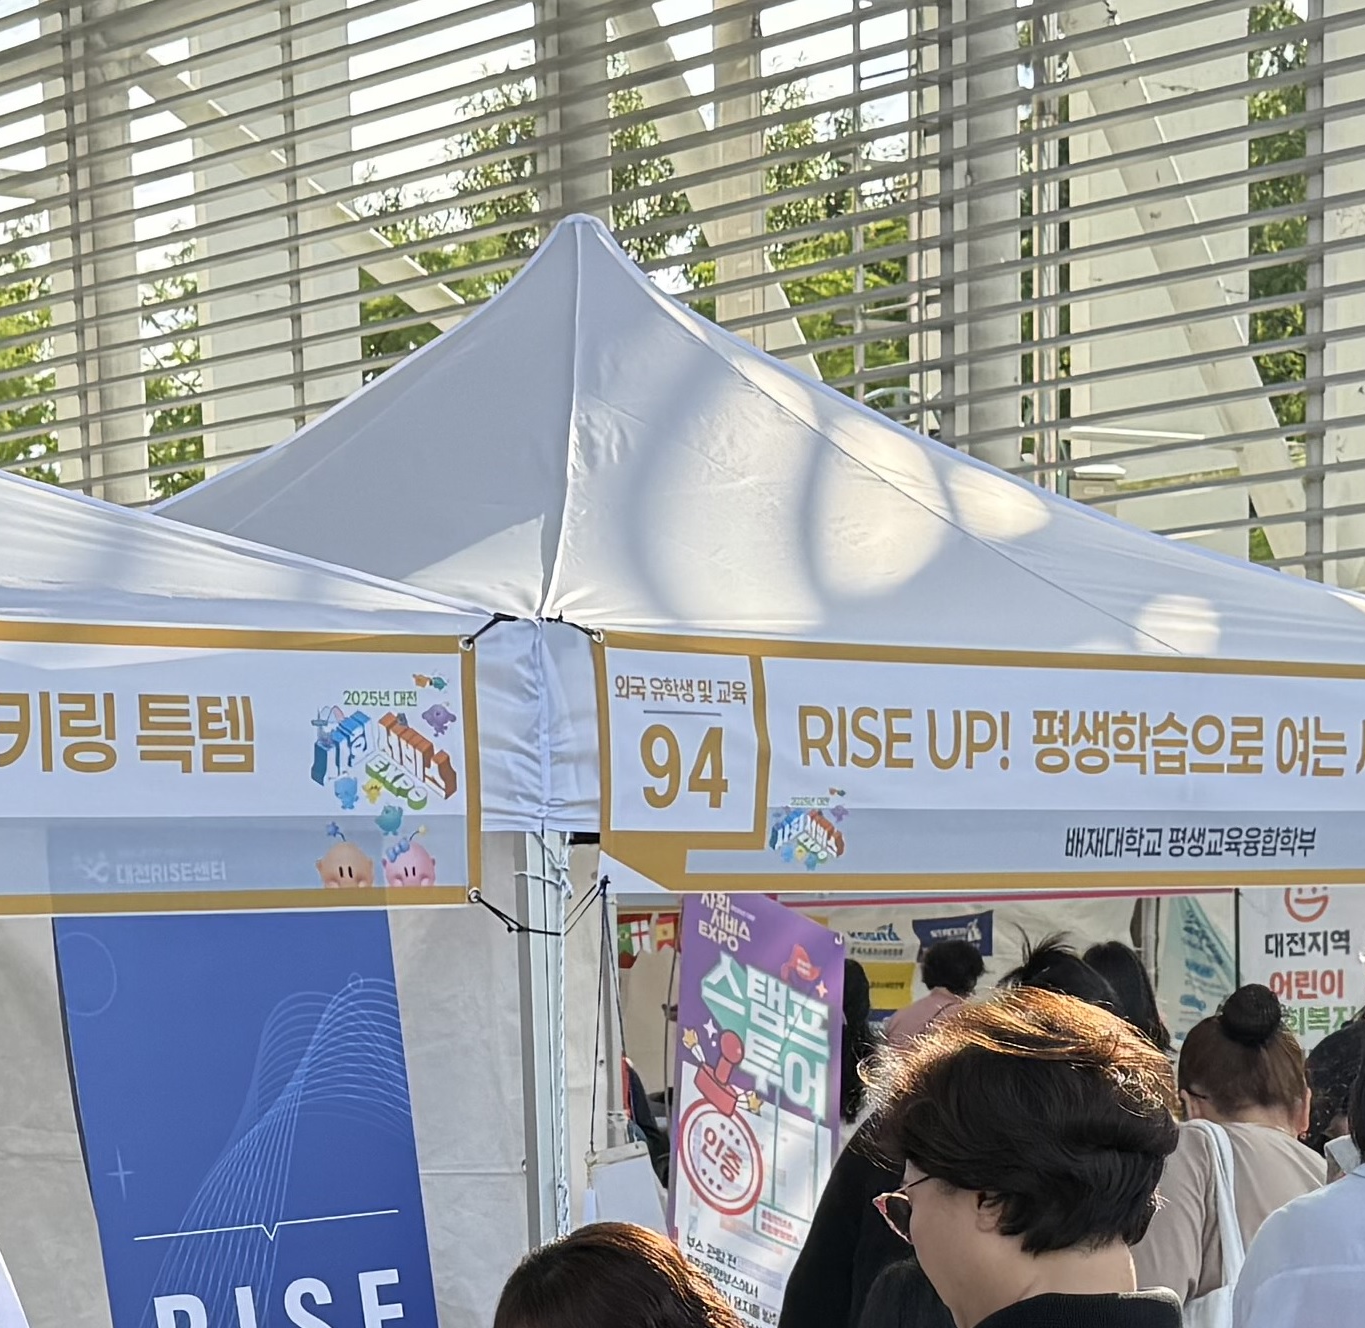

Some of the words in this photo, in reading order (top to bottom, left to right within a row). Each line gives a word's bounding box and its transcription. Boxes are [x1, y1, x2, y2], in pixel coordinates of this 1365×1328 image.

[342, 689, 390, 707] 2025년
[393, 690, 418, 707] 대전
[614, 674, 646, 701] 외국
[649, 677, 695, 703] 유학생
[697, 679, 713, 704] 및
[716, 680, 747, 705] 교육
[136, 692, 255, 774] 특템
[797, 704, 915, 770] RISE
[927, 708, 1011, 771] UP!
[1031, 709, 1265, 777] 평생학습으로
[1275, 715, 1348, 778] 여는
[365, 752, 428, 811] EXPO
[639, 724, 729, 810] 94
[1064, 826, 1163, 858] 배재대학교
[1168, 826, 1317, 858] 평생교육융합학부
[698, 919, 739, 952] EXPO
[710, 908, 751, 942] 서비스
[1264, 929, 1351, 959] 대전지역
[701, 952, 831, 1058] 스탬프
[1269, 968, 1344, 1001] 어린이
[739, 1028, 830, 1118] 투어
[701, 1126, 743, 1184] 인증
